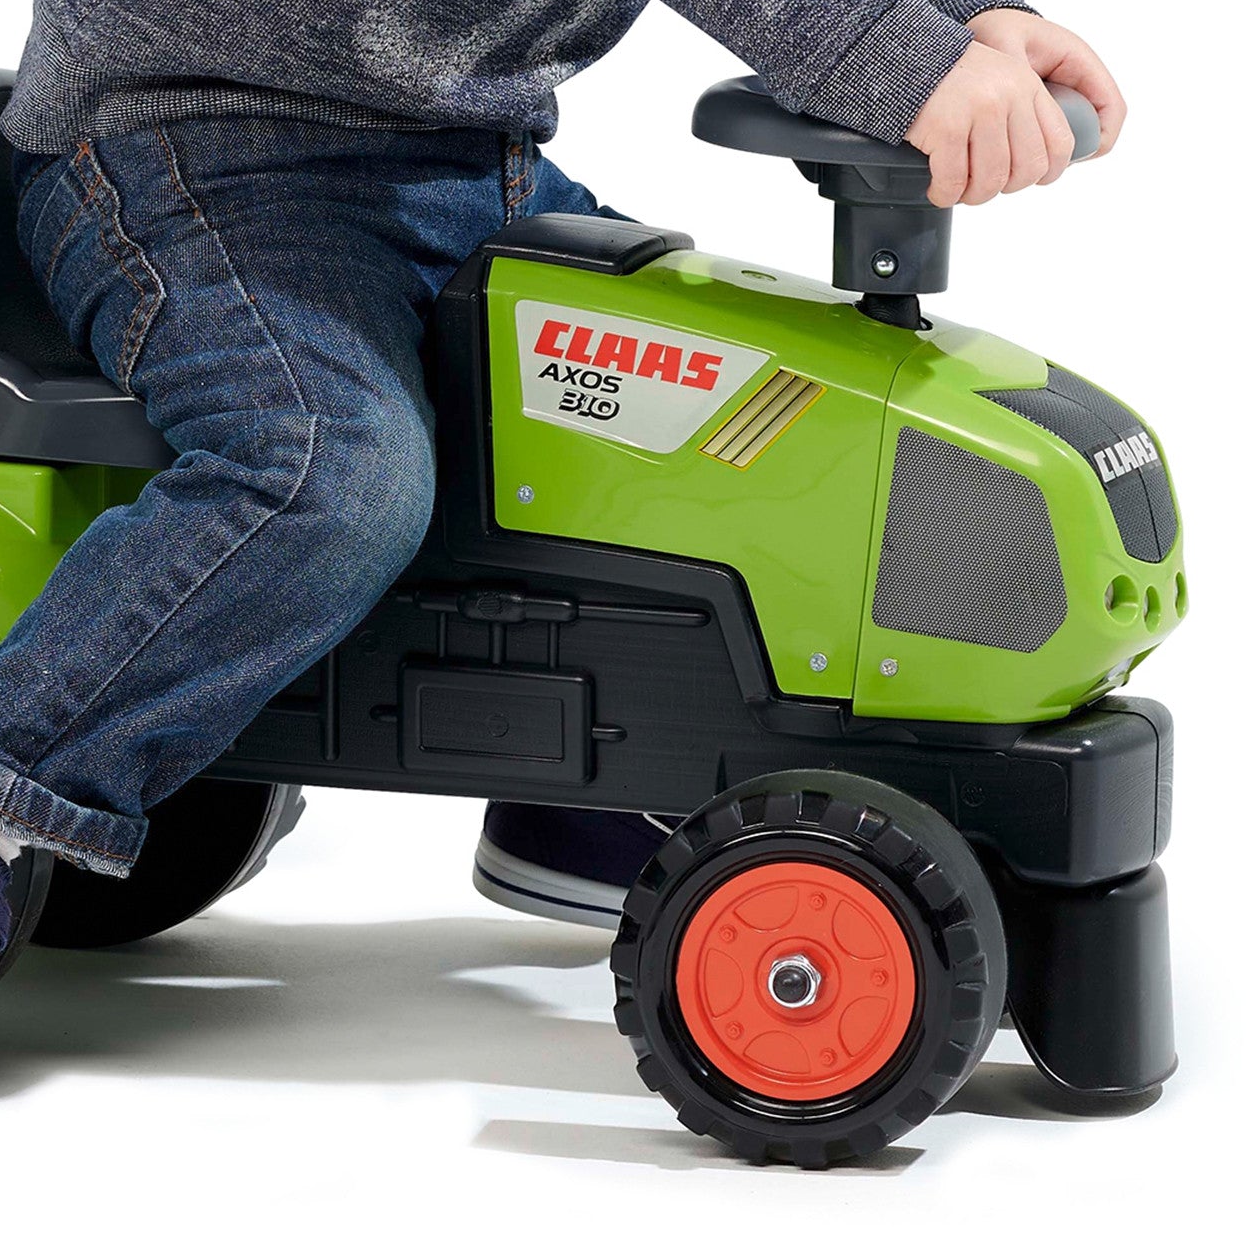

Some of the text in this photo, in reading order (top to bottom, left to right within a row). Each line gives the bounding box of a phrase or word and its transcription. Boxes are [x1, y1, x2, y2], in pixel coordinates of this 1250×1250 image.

[534, 320, 723, 391] CLAAS
[538, 362, 623, 394] AXOS
[558, 388, 620, 421] 310
[1093, 431, 1158, 483] CLAAS
